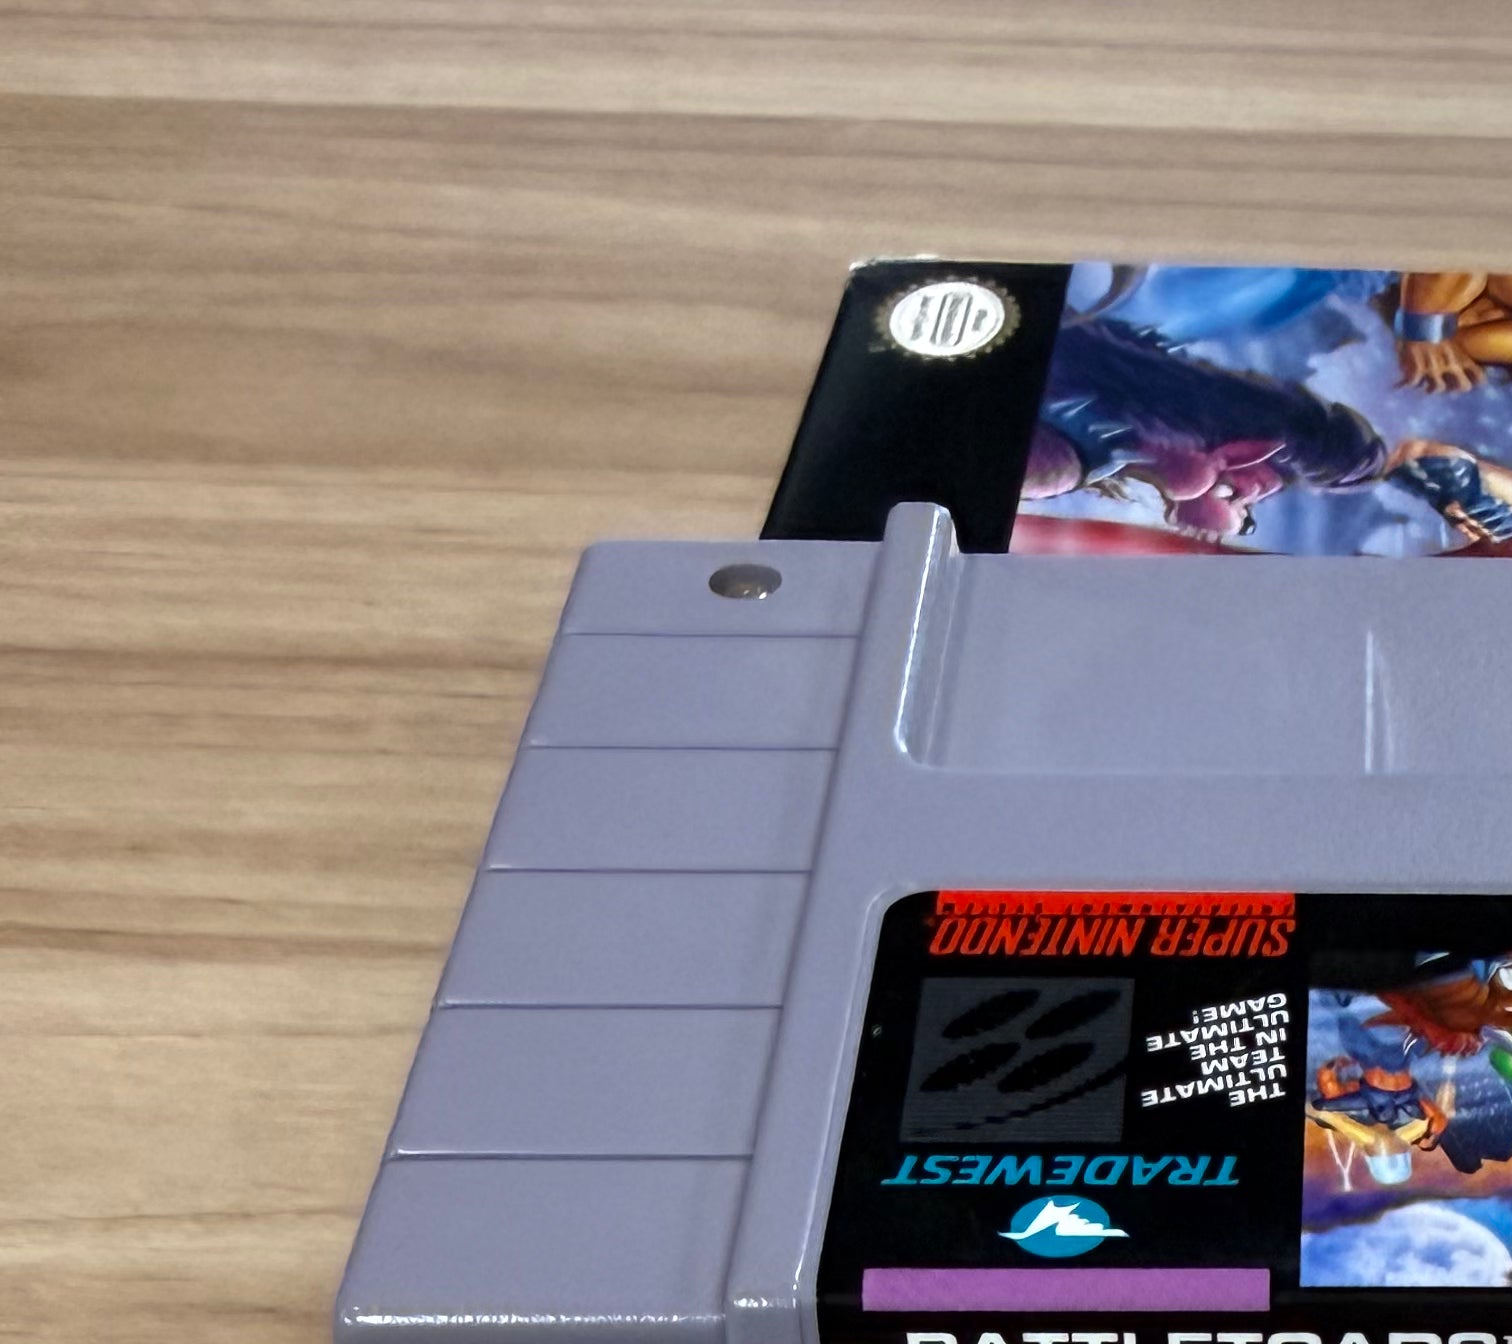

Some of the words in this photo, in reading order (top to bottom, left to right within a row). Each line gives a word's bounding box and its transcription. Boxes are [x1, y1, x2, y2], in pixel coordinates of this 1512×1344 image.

[929, 917, 1145, 956] NINTENDO
[1149, 917, 1297, 956] SUPER
[1192, 992, 1288, 1025] GAME!
[1145, 1009, 1290, 1053] ULTIMATE
[1255, 1027, 1287, 1047] IN
[1189, 1037, 1247, 1061] THE
[1200, 1046, 1286, 1076] TEAM
[1140, 1063, 1288, 1108] ULTIMATE
[1228, 1083, 1287, 1107] THE
[881, 1154, 1239, 1187] TRADEWEST
